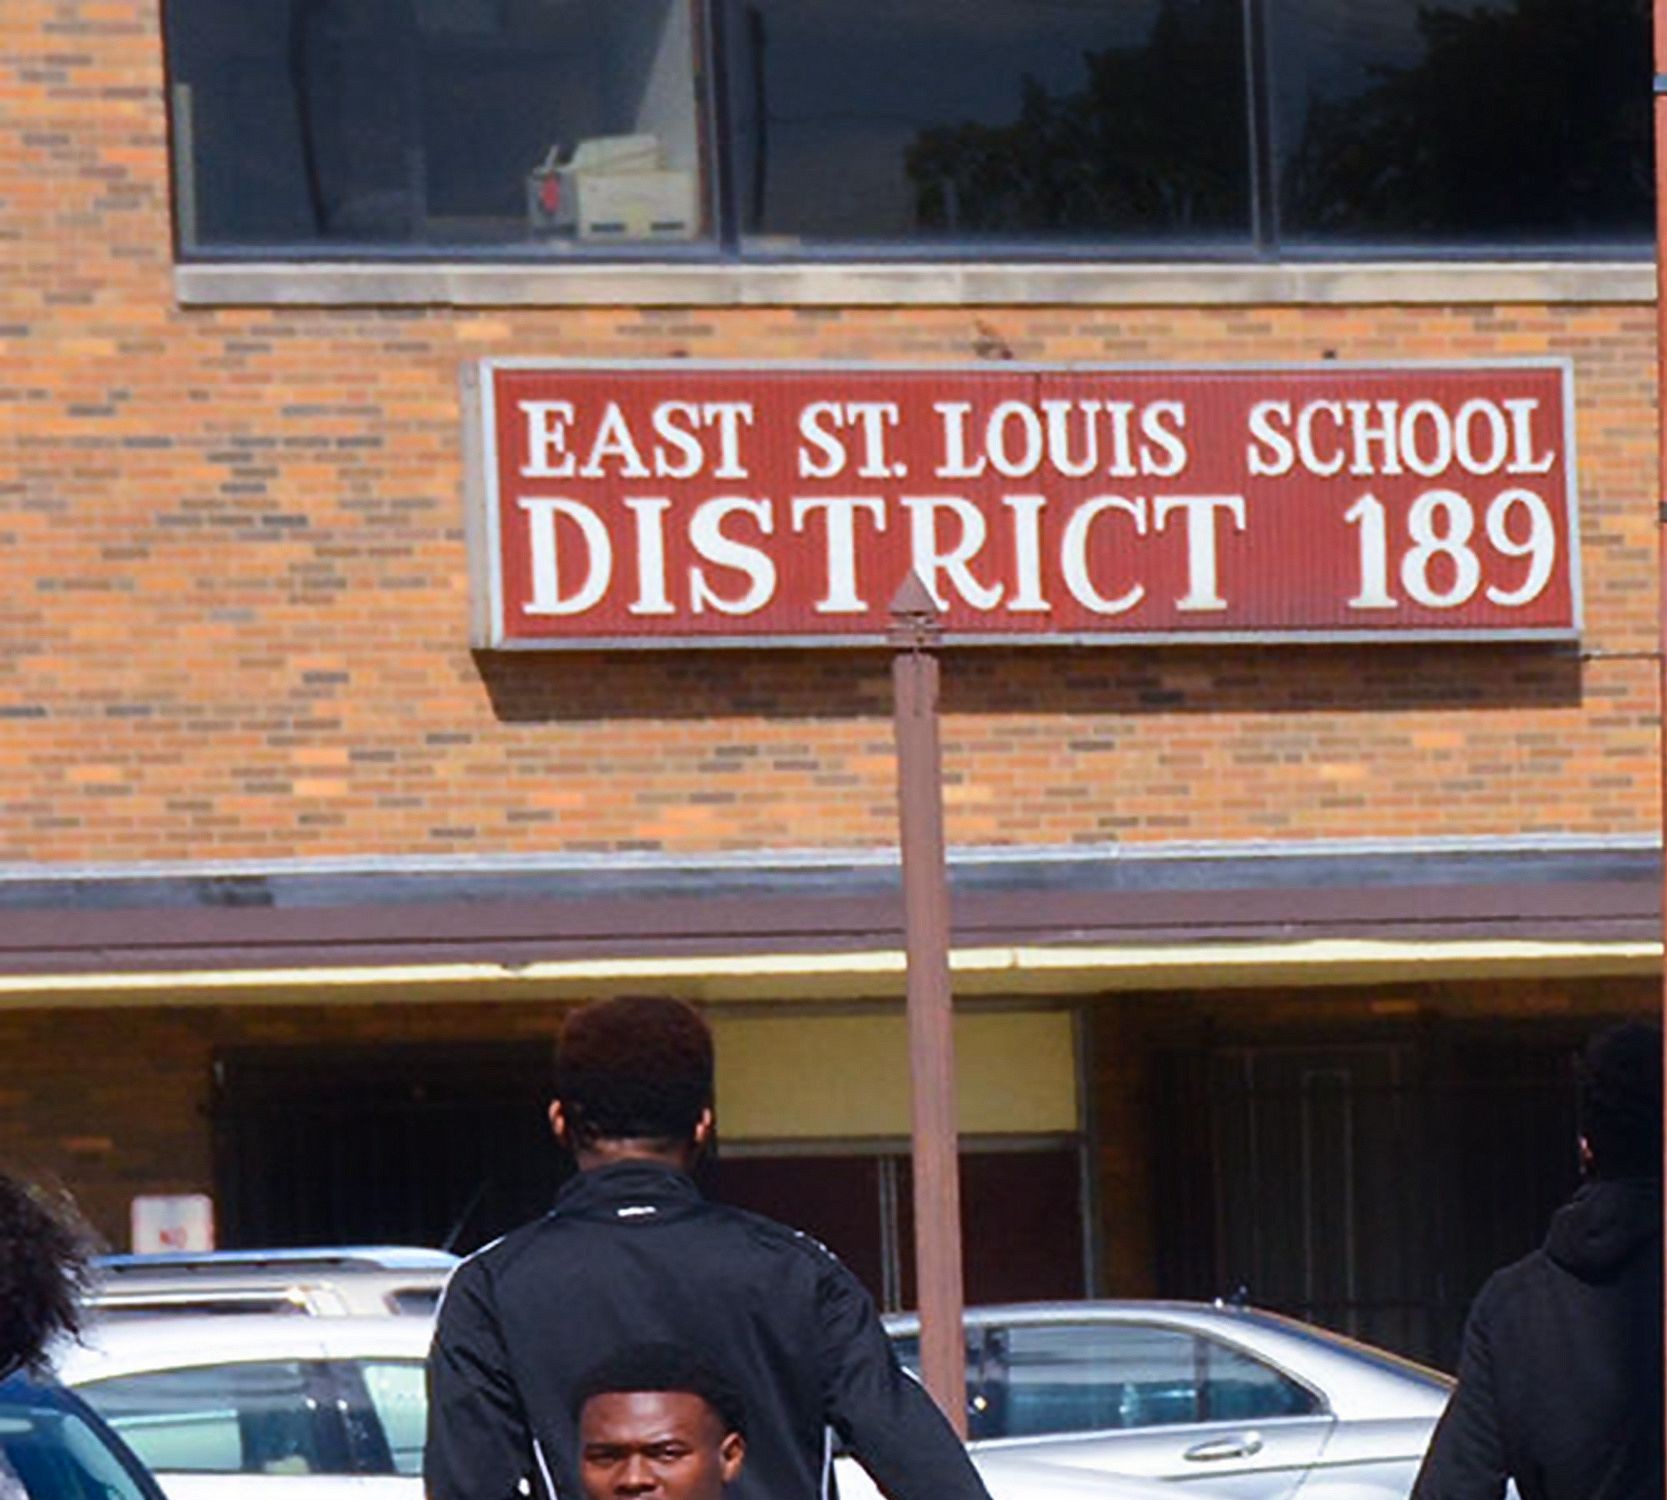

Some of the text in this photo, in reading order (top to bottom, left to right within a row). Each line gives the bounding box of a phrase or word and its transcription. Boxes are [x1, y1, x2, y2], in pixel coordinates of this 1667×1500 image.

[518, 397, 1555, 479] EAST ST. LOUIS SCHOOL
[517, 487, 1556, 615] DISTRICT 189
